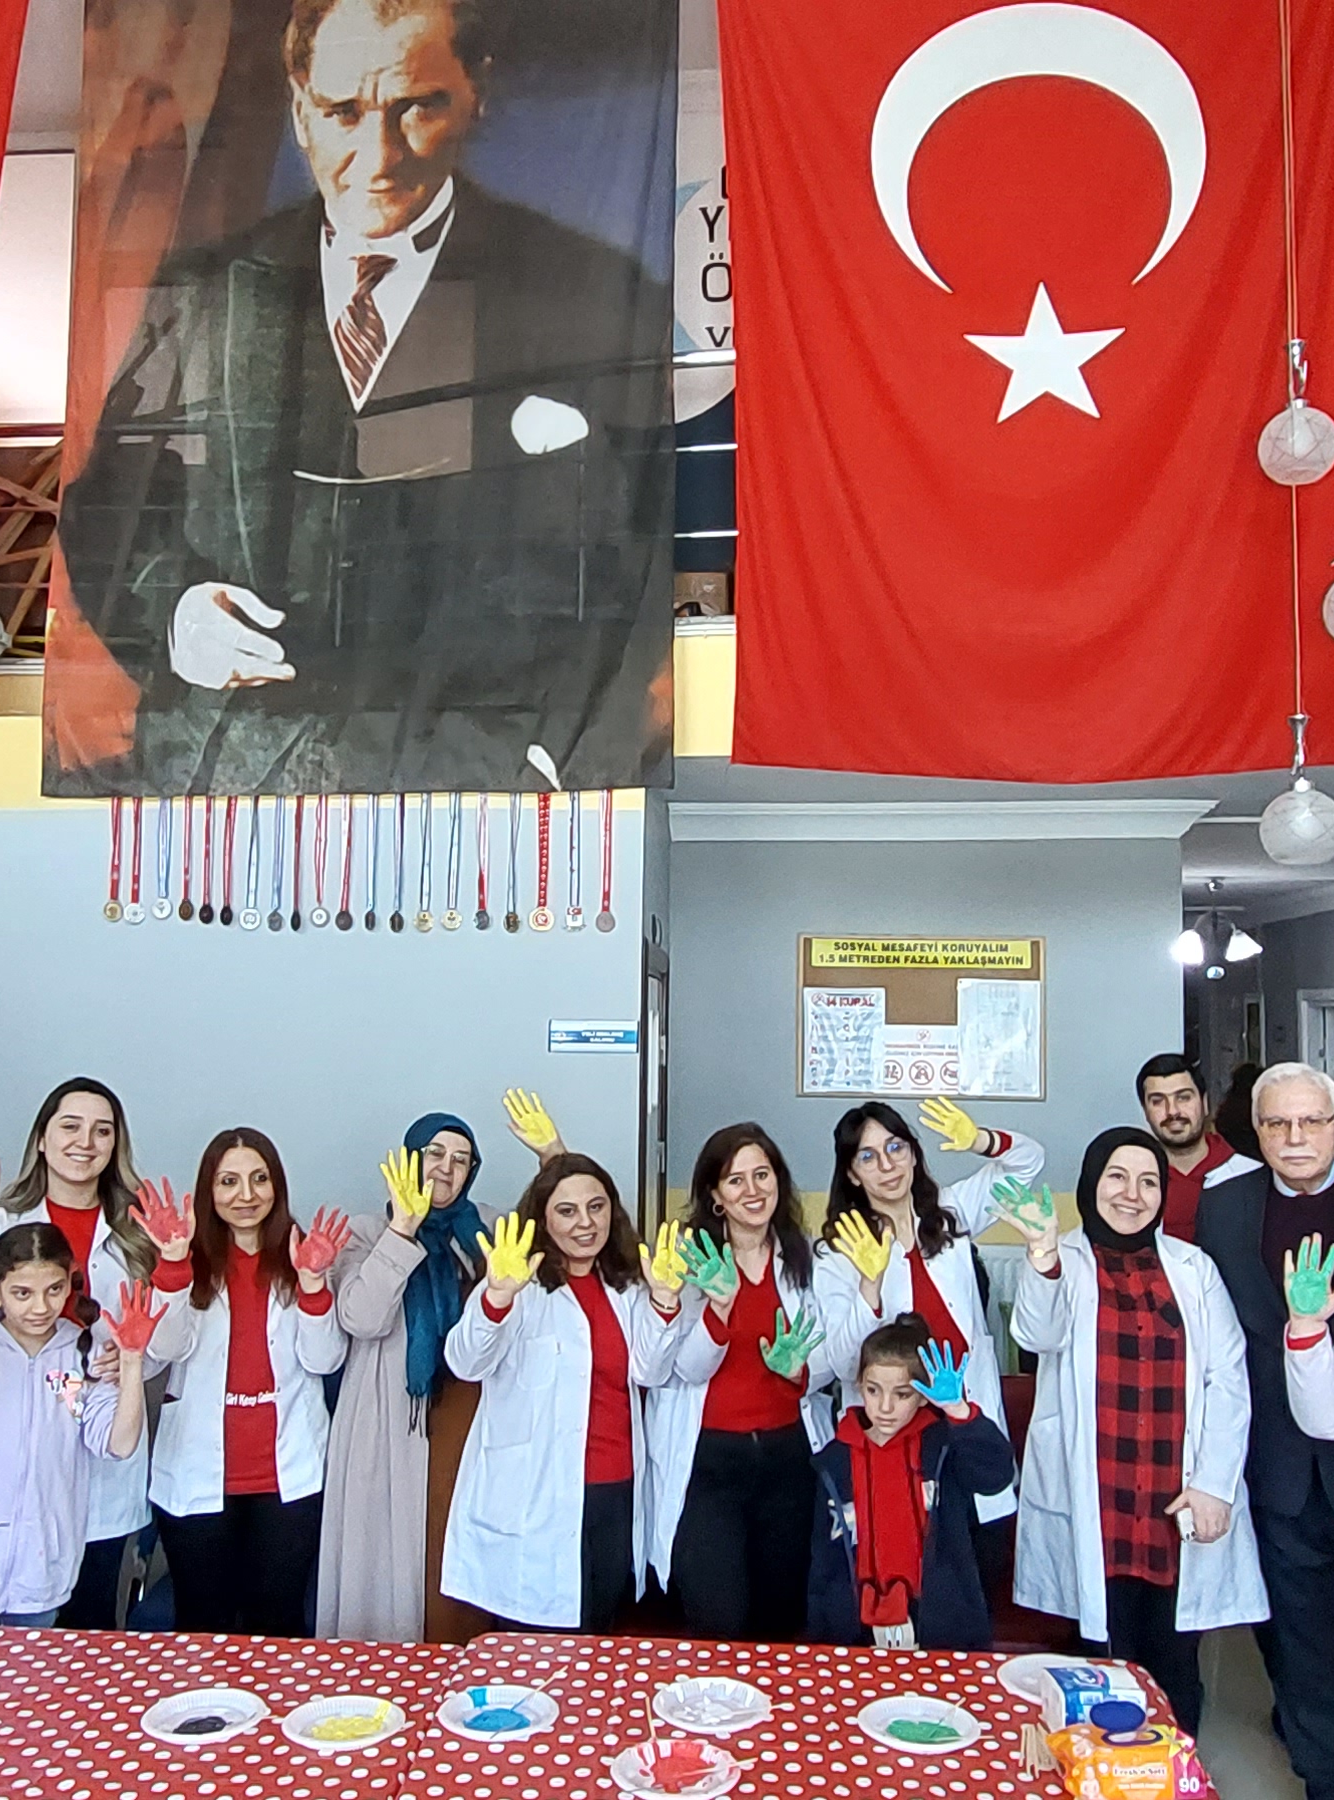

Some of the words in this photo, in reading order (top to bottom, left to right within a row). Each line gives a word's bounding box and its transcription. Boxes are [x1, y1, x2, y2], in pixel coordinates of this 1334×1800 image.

[833, 941, 878, 951] SOSYAL
[881, 941, 938, 952] MESAFEYİ
[941, 943, 1009, 953] KORUYALIM
[818, 954, 835, 963] 1.5
[838, 954, 901, 964] METREDEN
[903, 955, 939, 965] FAZLA
[942, 955, 1024, 966] YAKLAŞMAYIN
[1179, 1777, 1200, 1793] 90
